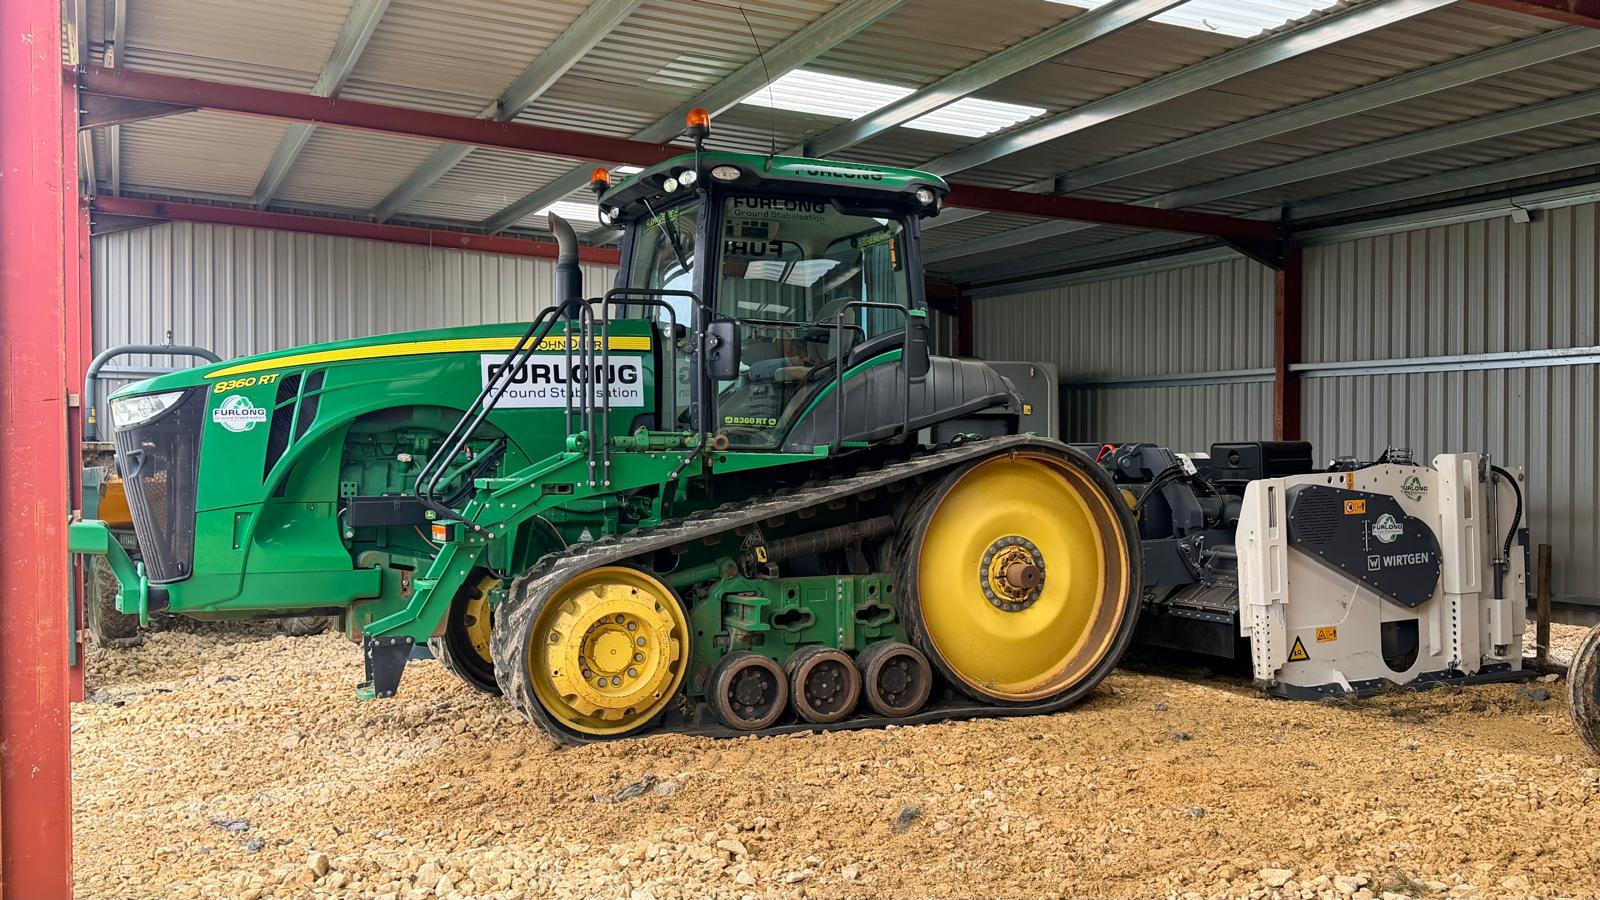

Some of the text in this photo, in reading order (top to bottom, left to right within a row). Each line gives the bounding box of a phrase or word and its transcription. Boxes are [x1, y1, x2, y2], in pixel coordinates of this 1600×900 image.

[733, 197, 825, 213] FURLONG
[734, 208, 825, 224] Ground Stabilisation
[537, 340, 566, 350] OHN
[487, 363, 639, 384] FURLONG
[213, 373, 280, 394] 8360 RT
[733, 416, 768, 426] 8360 RT
[1382, 552, 1429, 567] WIRTGEN
